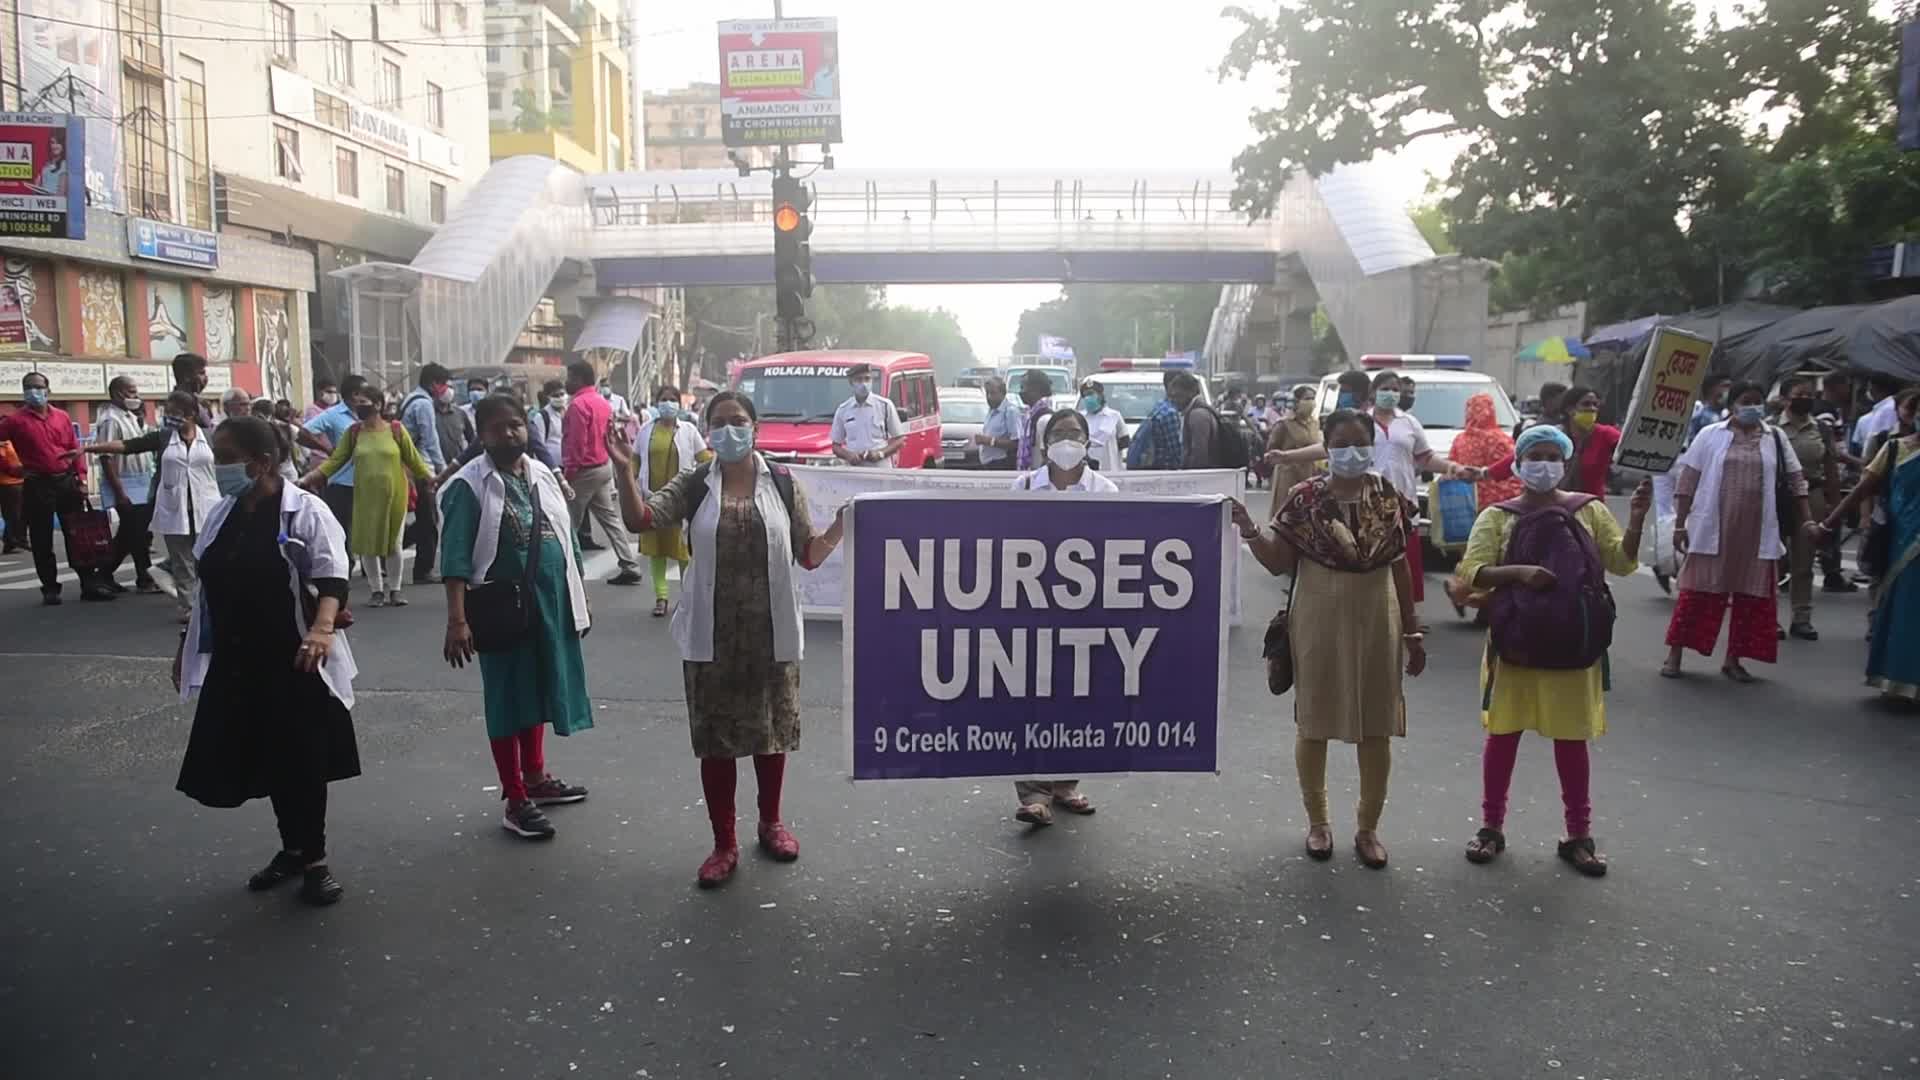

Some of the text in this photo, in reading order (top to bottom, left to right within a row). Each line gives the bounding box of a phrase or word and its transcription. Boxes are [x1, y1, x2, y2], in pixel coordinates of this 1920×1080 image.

[731, 53, 801, 68] ARENA
[737, 103, 799, 115] ANIMATION
[36, 199, 57, 209] WEB
[764, 366, 851, 377] KOLKATA POLIC
[884, 537, 1194, 610] NURSES
[921, 627, 1160, 700] UNITY
[874, 721, 1196, 756] 9 Creek Row, Kolkata 700 014
